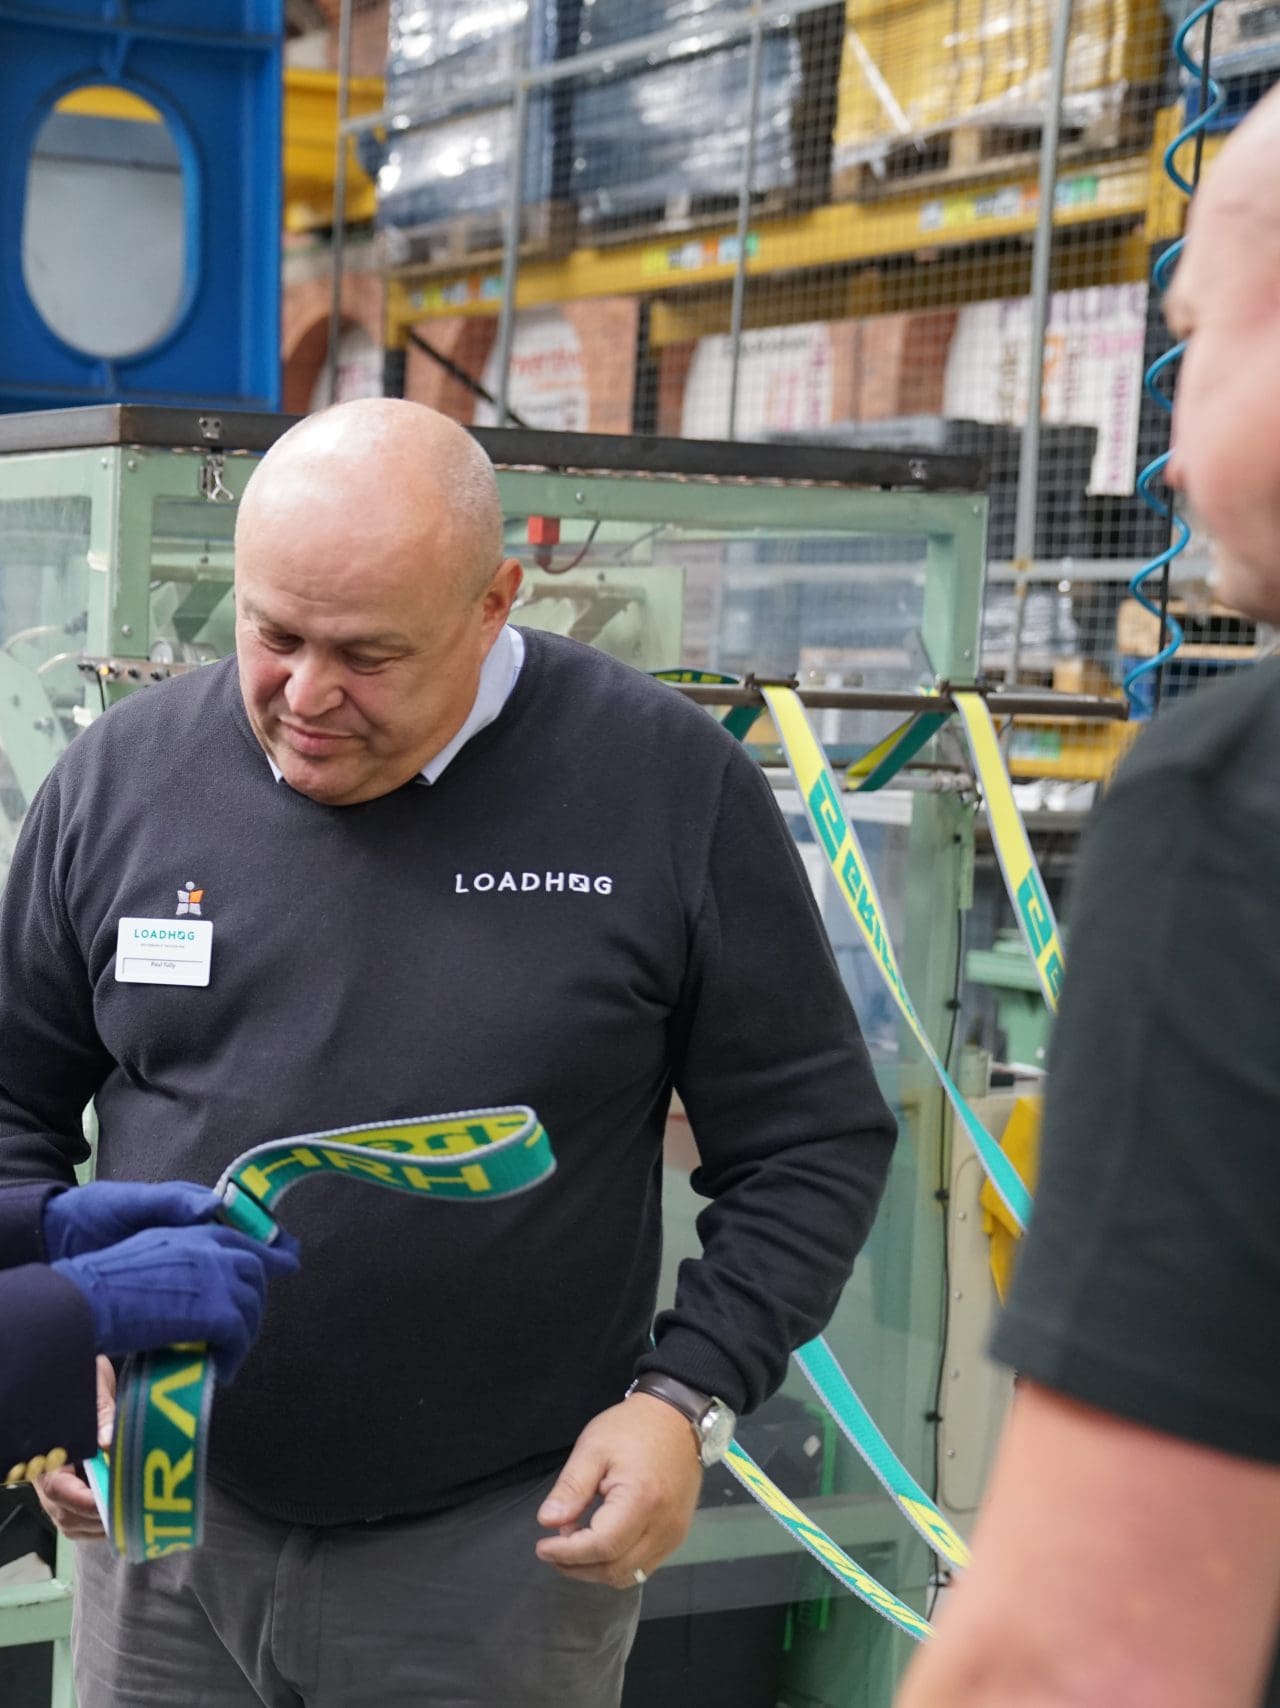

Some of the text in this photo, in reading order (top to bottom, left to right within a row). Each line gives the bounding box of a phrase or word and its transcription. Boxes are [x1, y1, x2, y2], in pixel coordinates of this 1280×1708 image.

[455, 871, 613, 895] LOADHOG
[133, 928, 196, 941] LOADHOG
[239, 1147, 493, 1200] HRH
